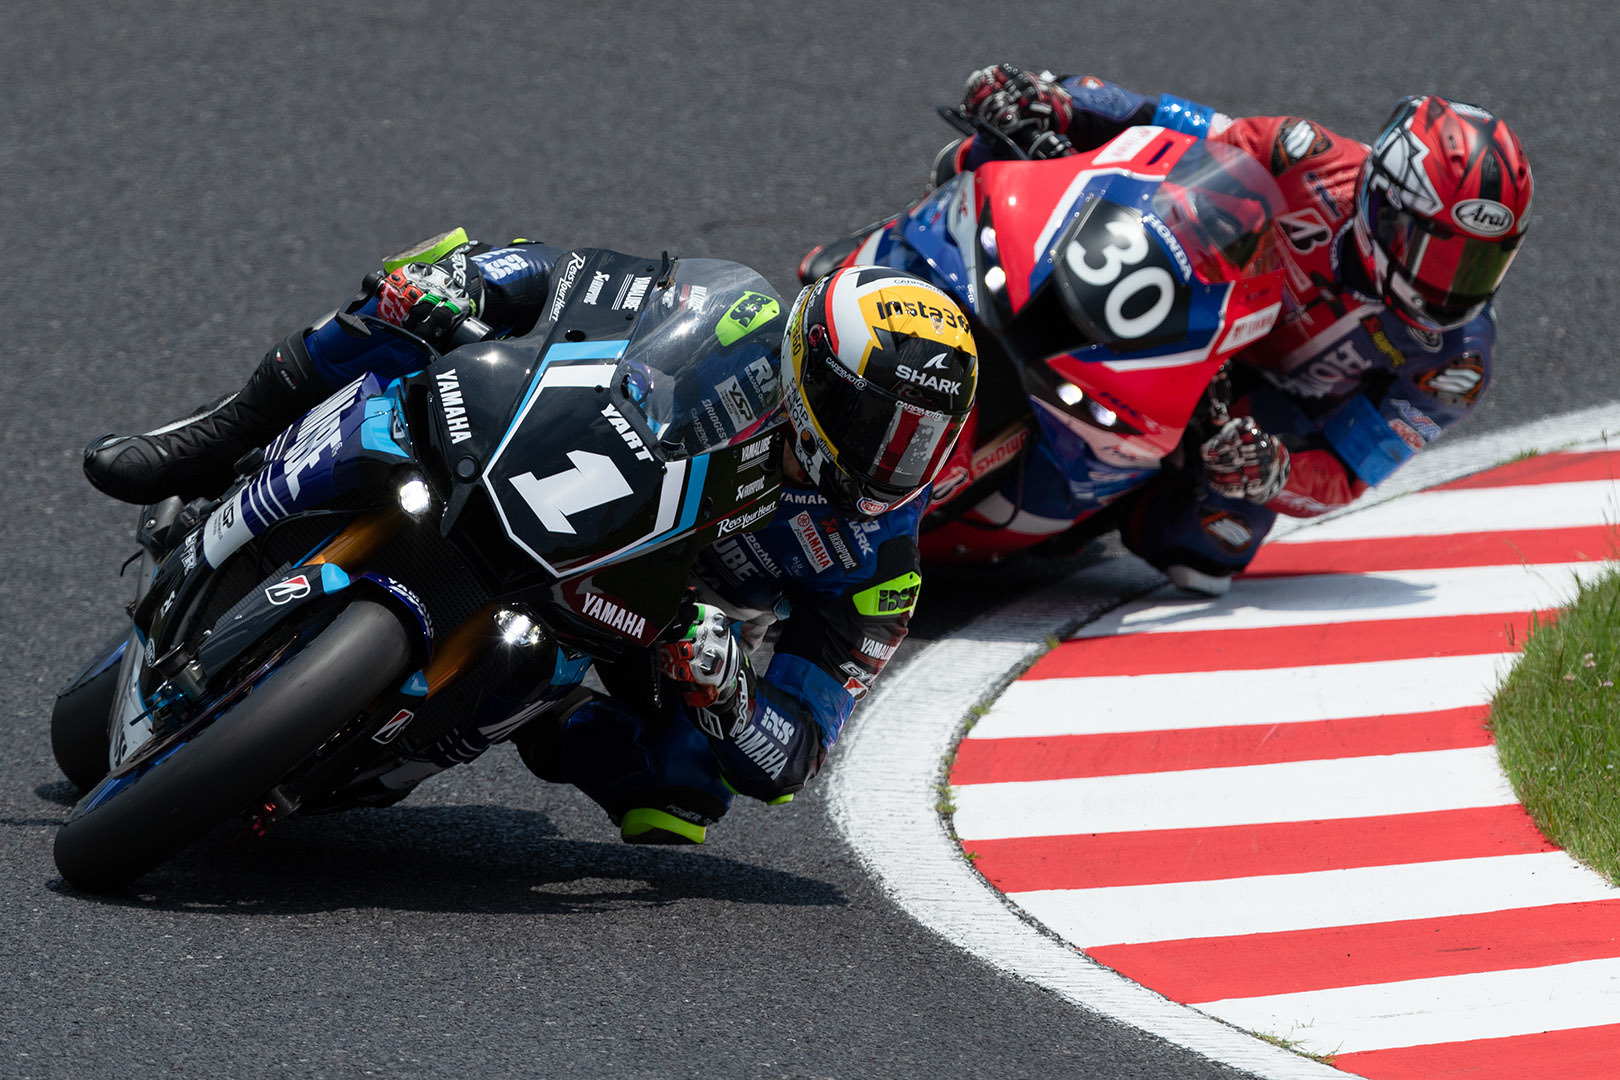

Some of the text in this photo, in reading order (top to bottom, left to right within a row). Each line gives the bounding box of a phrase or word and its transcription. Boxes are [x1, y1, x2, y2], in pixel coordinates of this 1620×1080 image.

[1463, 203, 1507, 228] Arai
[1148, 212, 1192, 282] HONDA
[1066, 221, 1175, 339] 30
[895, 364, 961, 396] SHARK
[435, 368, 472, 445] YAMAHA
[690, 408, 713, 449] CARPIM
[701, 399, 730, 441] BRIDGEST
[600, 403, 655, 462] YART
[508, 449, 634, 535] 1
[780, 492, 828, 505] YAMAH
[802, 525, 832, 569] YAMAHA
[581, 592, 646, 639] YAMAHA
[735, 724, 788, 781] AMAHA
